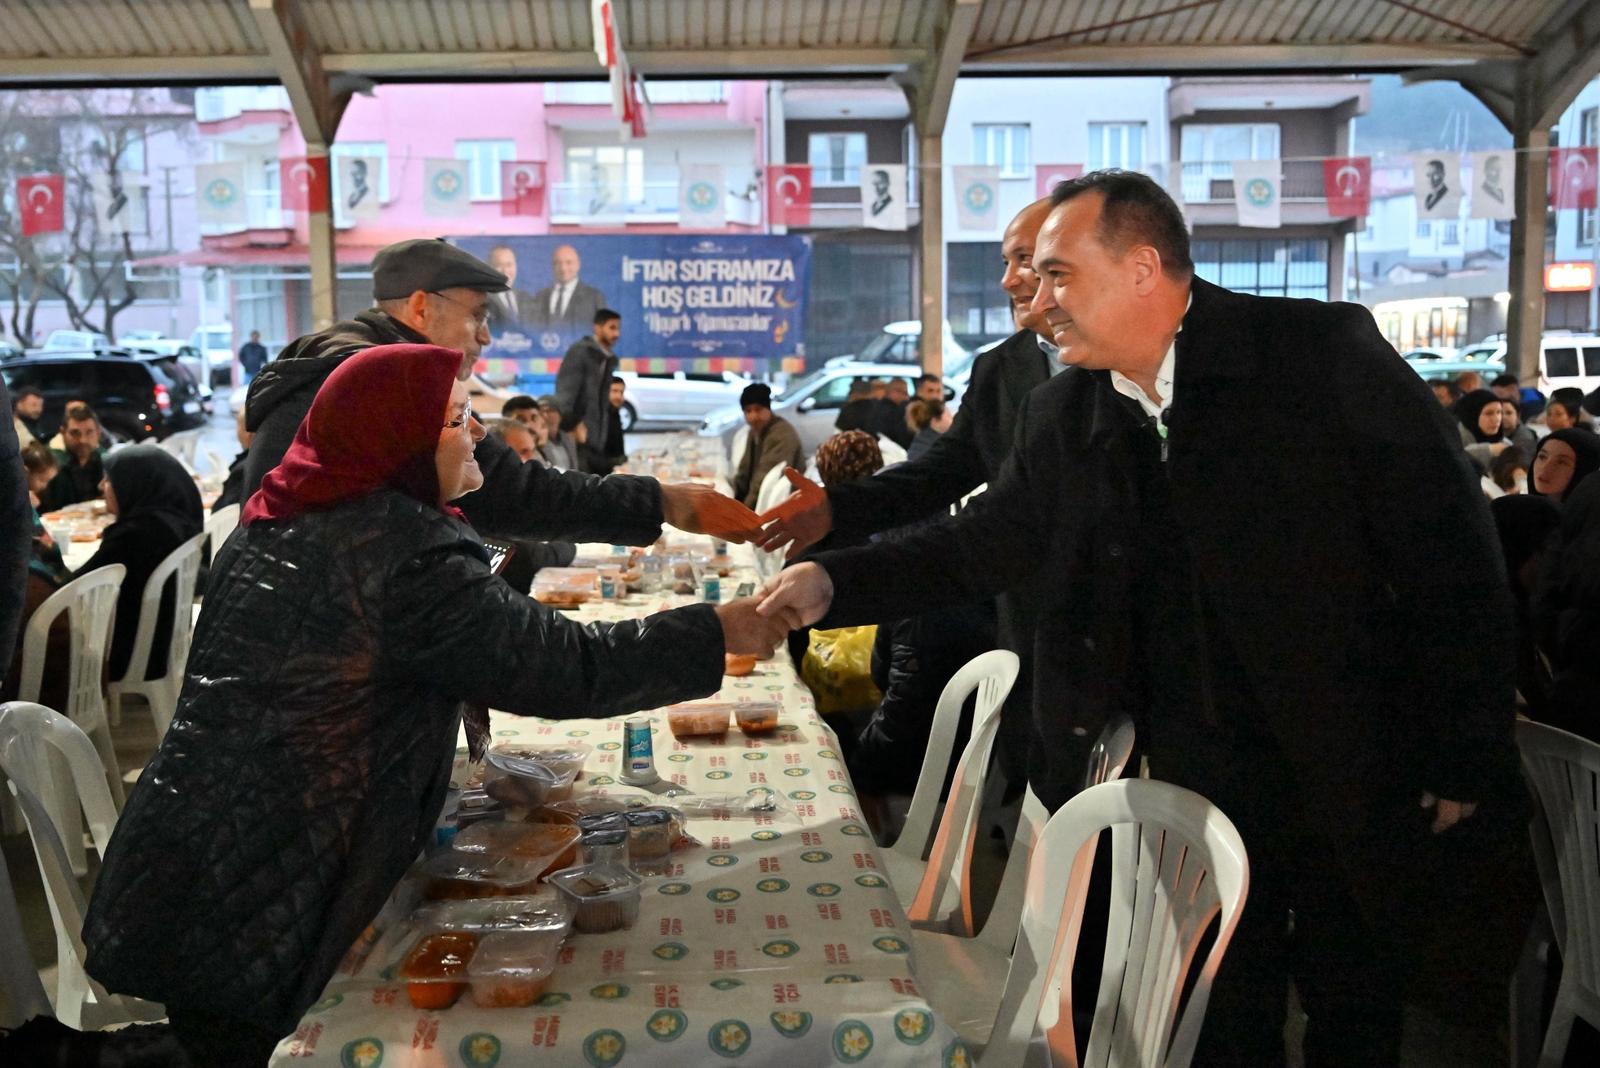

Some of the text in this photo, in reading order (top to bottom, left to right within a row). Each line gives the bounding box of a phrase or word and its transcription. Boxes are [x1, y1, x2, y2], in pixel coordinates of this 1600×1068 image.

[622, 255, 795, 282] İFTAR SOFRAMIZA
[642, 281, 775, 313] HOŞ GELDİNİZ
